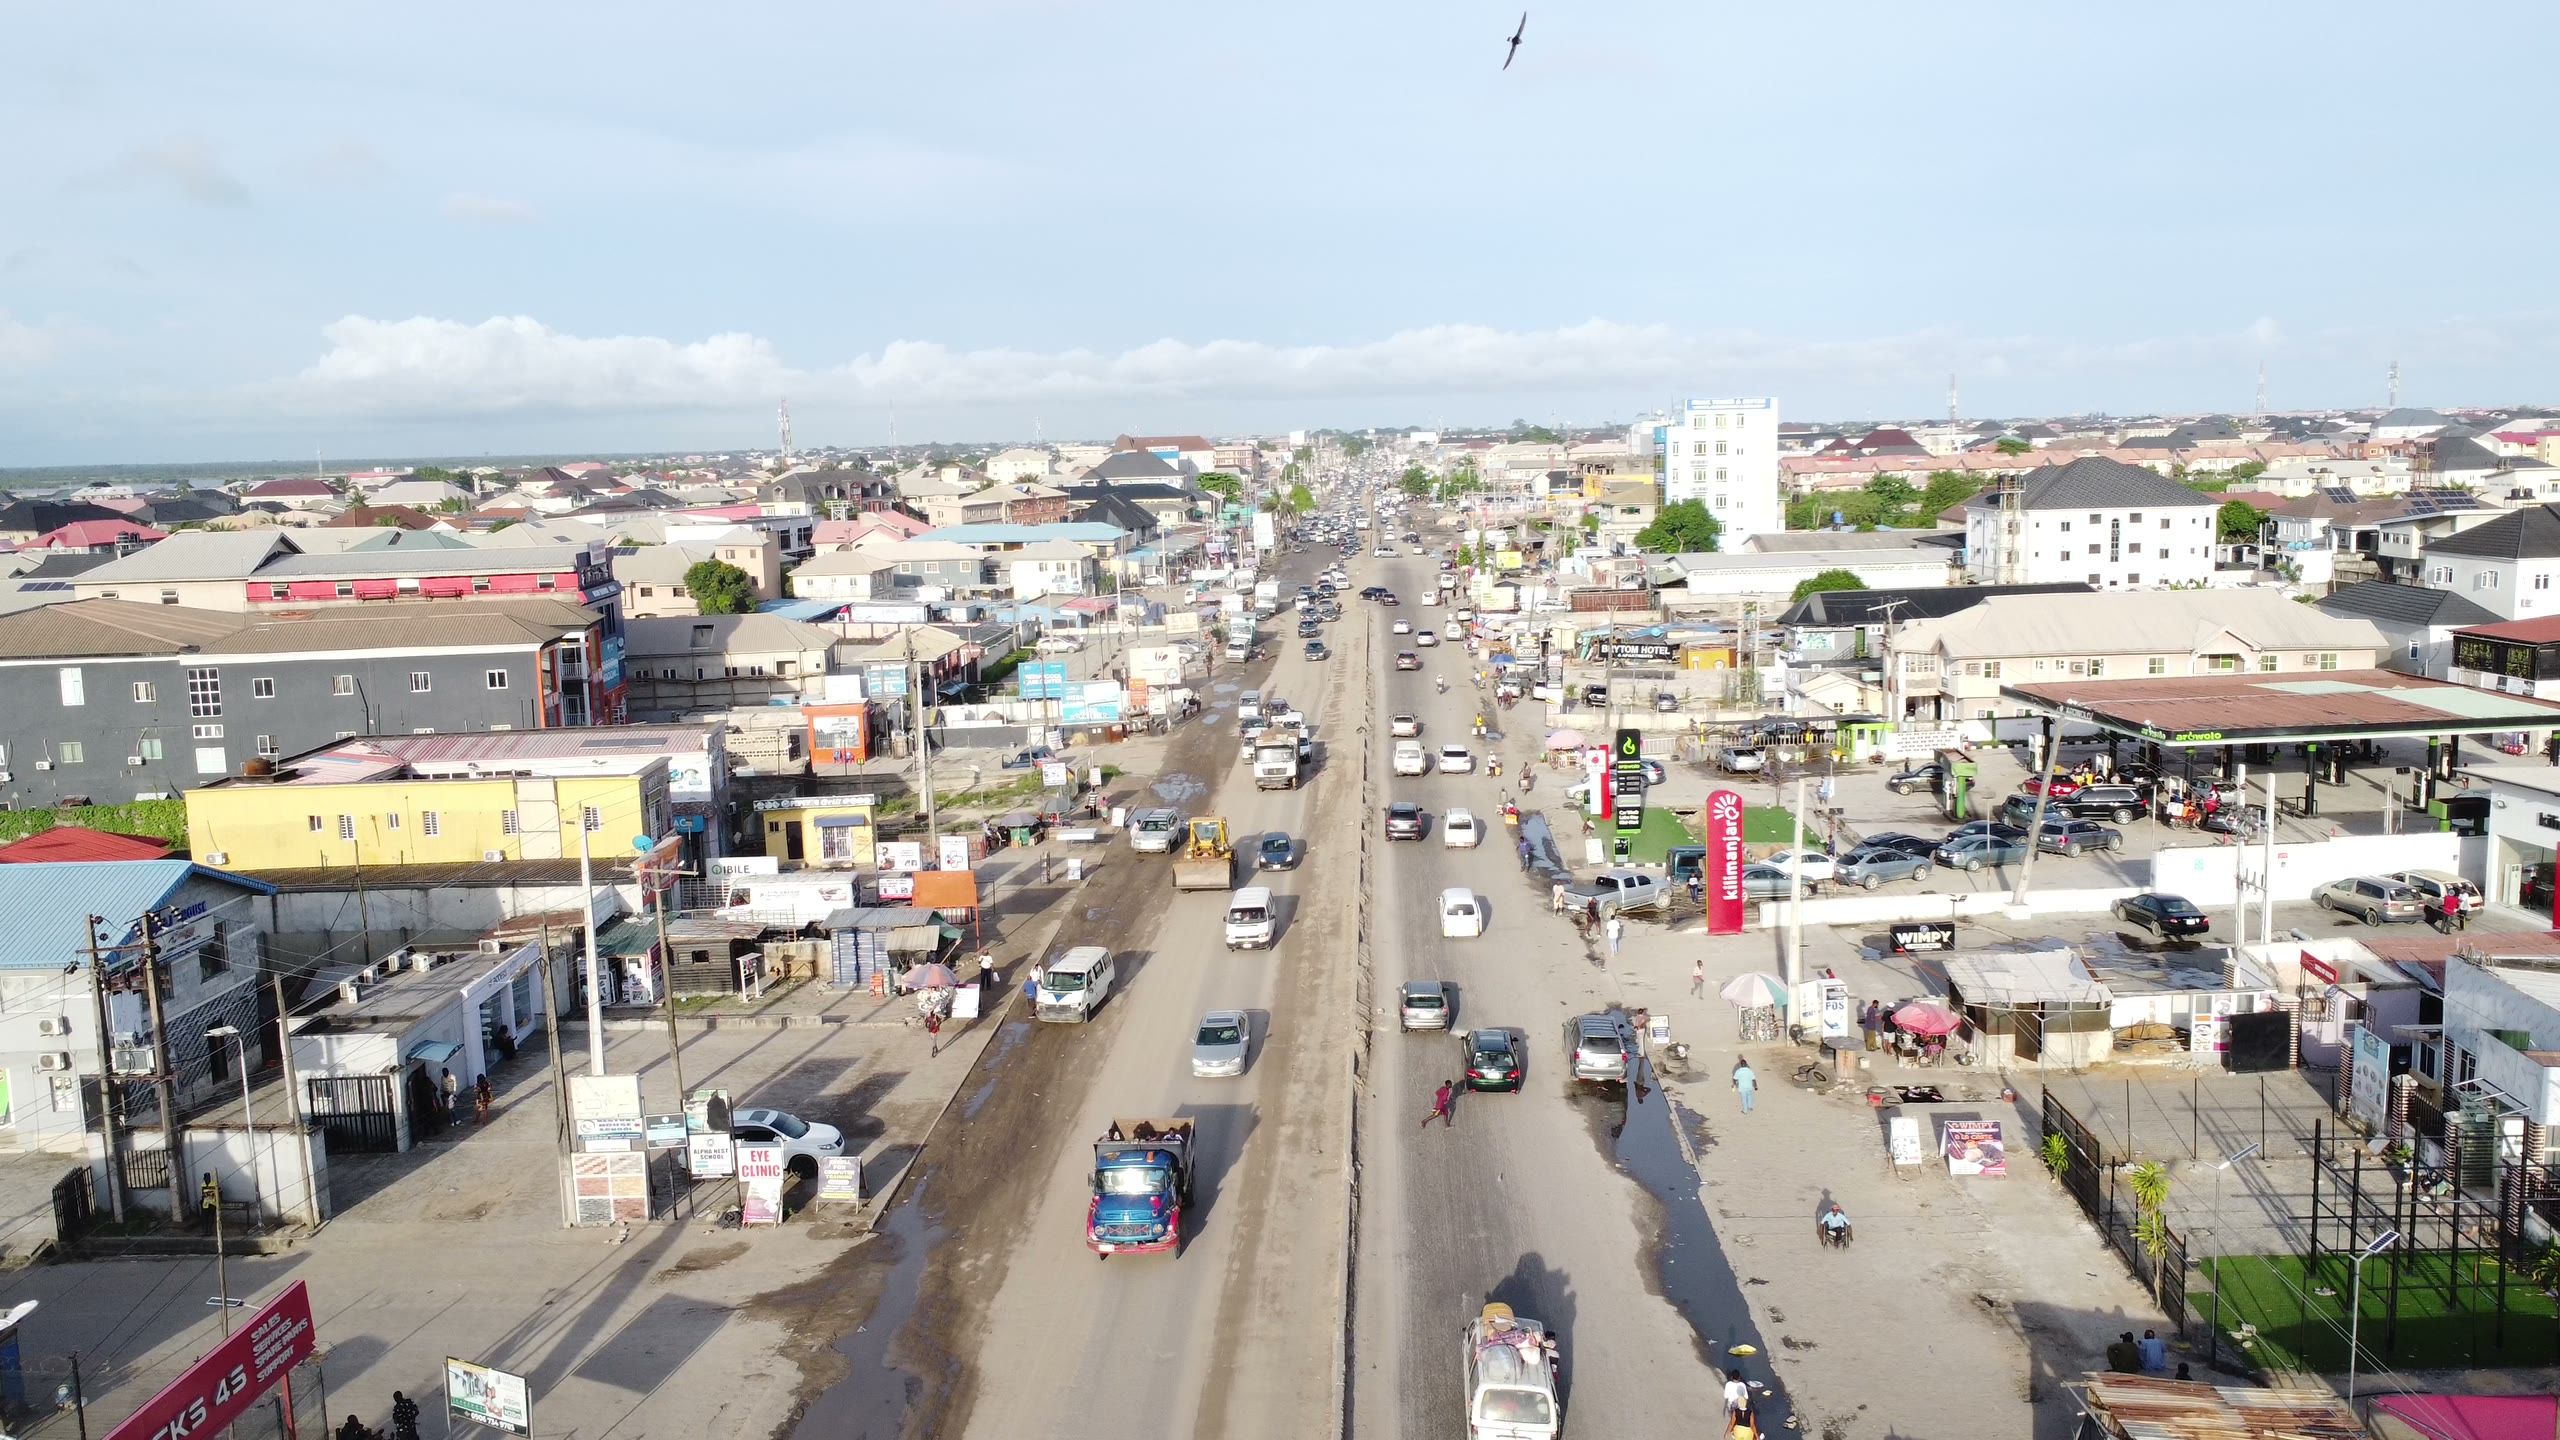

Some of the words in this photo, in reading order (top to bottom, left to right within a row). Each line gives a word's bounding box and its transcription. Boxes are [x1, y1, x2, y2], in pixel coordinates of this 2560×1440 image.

[1641, 645, 1670, 655] HOTEL
[1722, 806, 1741, 900] kilimanjaro
[723, 865, 751, 874] IBILE
[1896, 931, 1952, 944] WIMPY
[1826, 1001, 1845, 1010] POS
[750, 1150, 770, 1162] EYE
[741, 1164, 781, 1177] CLINIC
[251, 1312, 281, 1342] SALES
[252, 1317, 292, 1356] SERVICES
[255, 1339, 284, 1368] SPARE
[281, 1317, 308, 1348] PARTS
[256, 1345, 295, 1383] SUPPORT
[215, 1364, 248, 1406] 45
